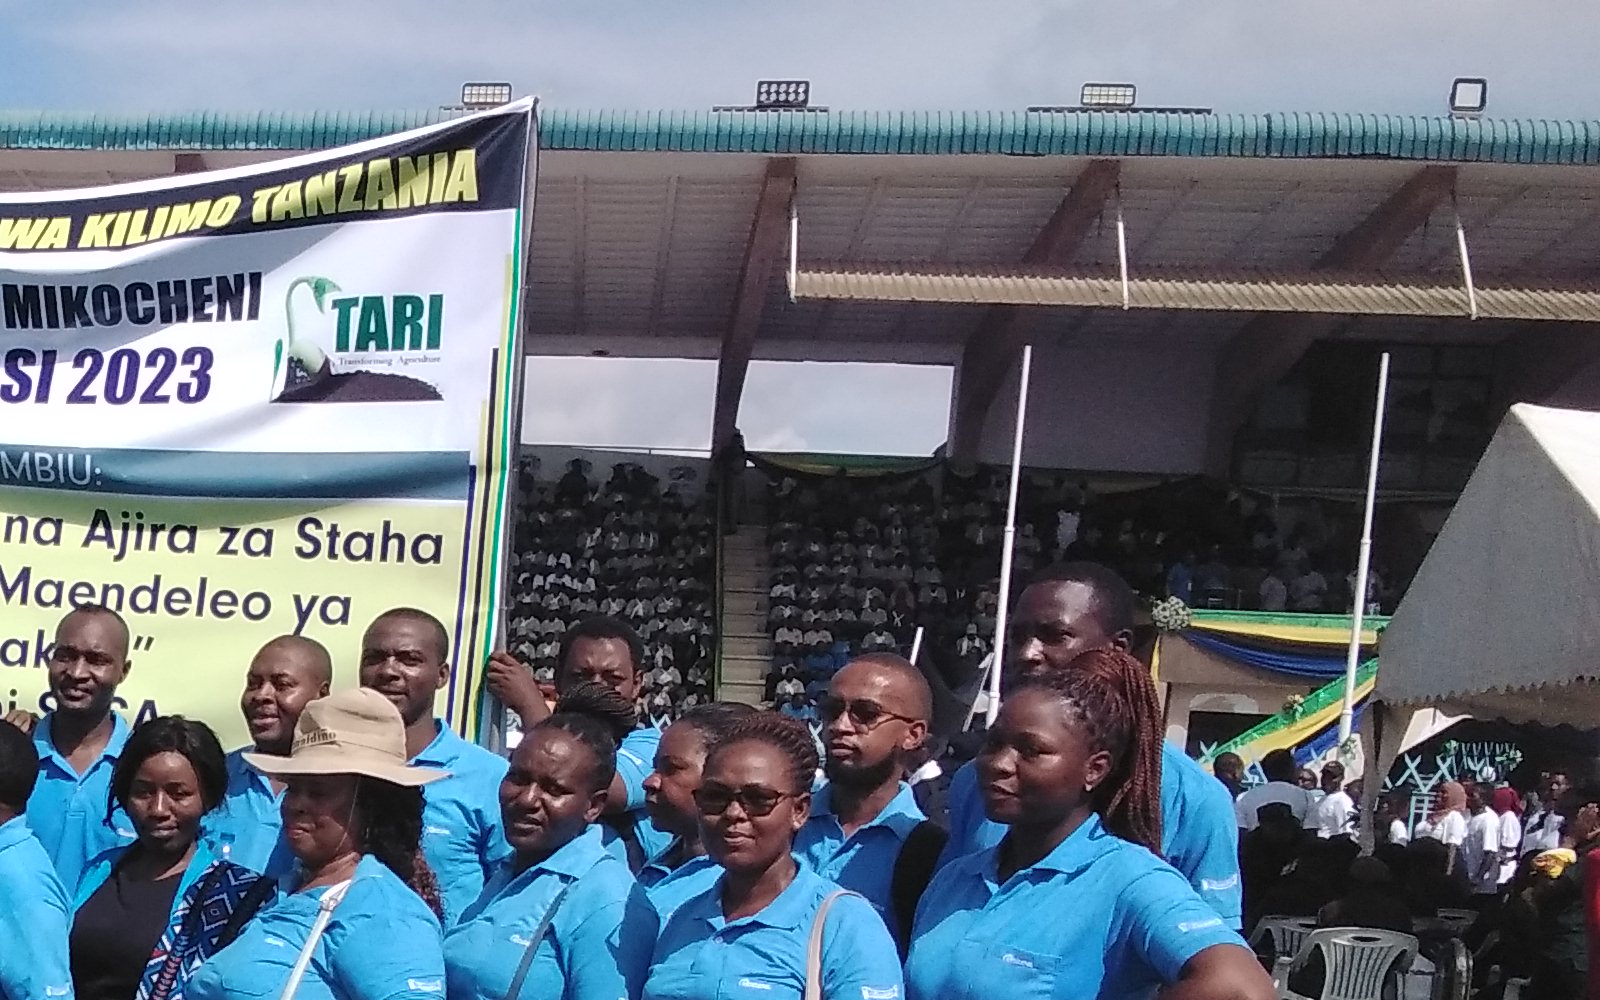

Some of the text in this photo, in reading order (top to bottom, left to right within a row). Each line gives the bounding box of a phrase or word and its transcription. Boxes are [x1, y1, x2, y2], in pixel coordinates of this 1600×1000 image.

[77, 196, 242, 249] KILIMO
[252, 148, 479, 224] TANZANIA
[0, 271, 263, 329] MIKOCHENI
[331, 294, 443, 352] TARI
[65, 346, 214, 405] 2023
[0, 450, 103, 486] MBIU:
[3, 514, 63, 546] na
[81, 508, 198, 562] Ajira
[216, 525, 274, 557] za
[294, 517, 444, 565] Staha
[292, 592, 352, 636] ya
